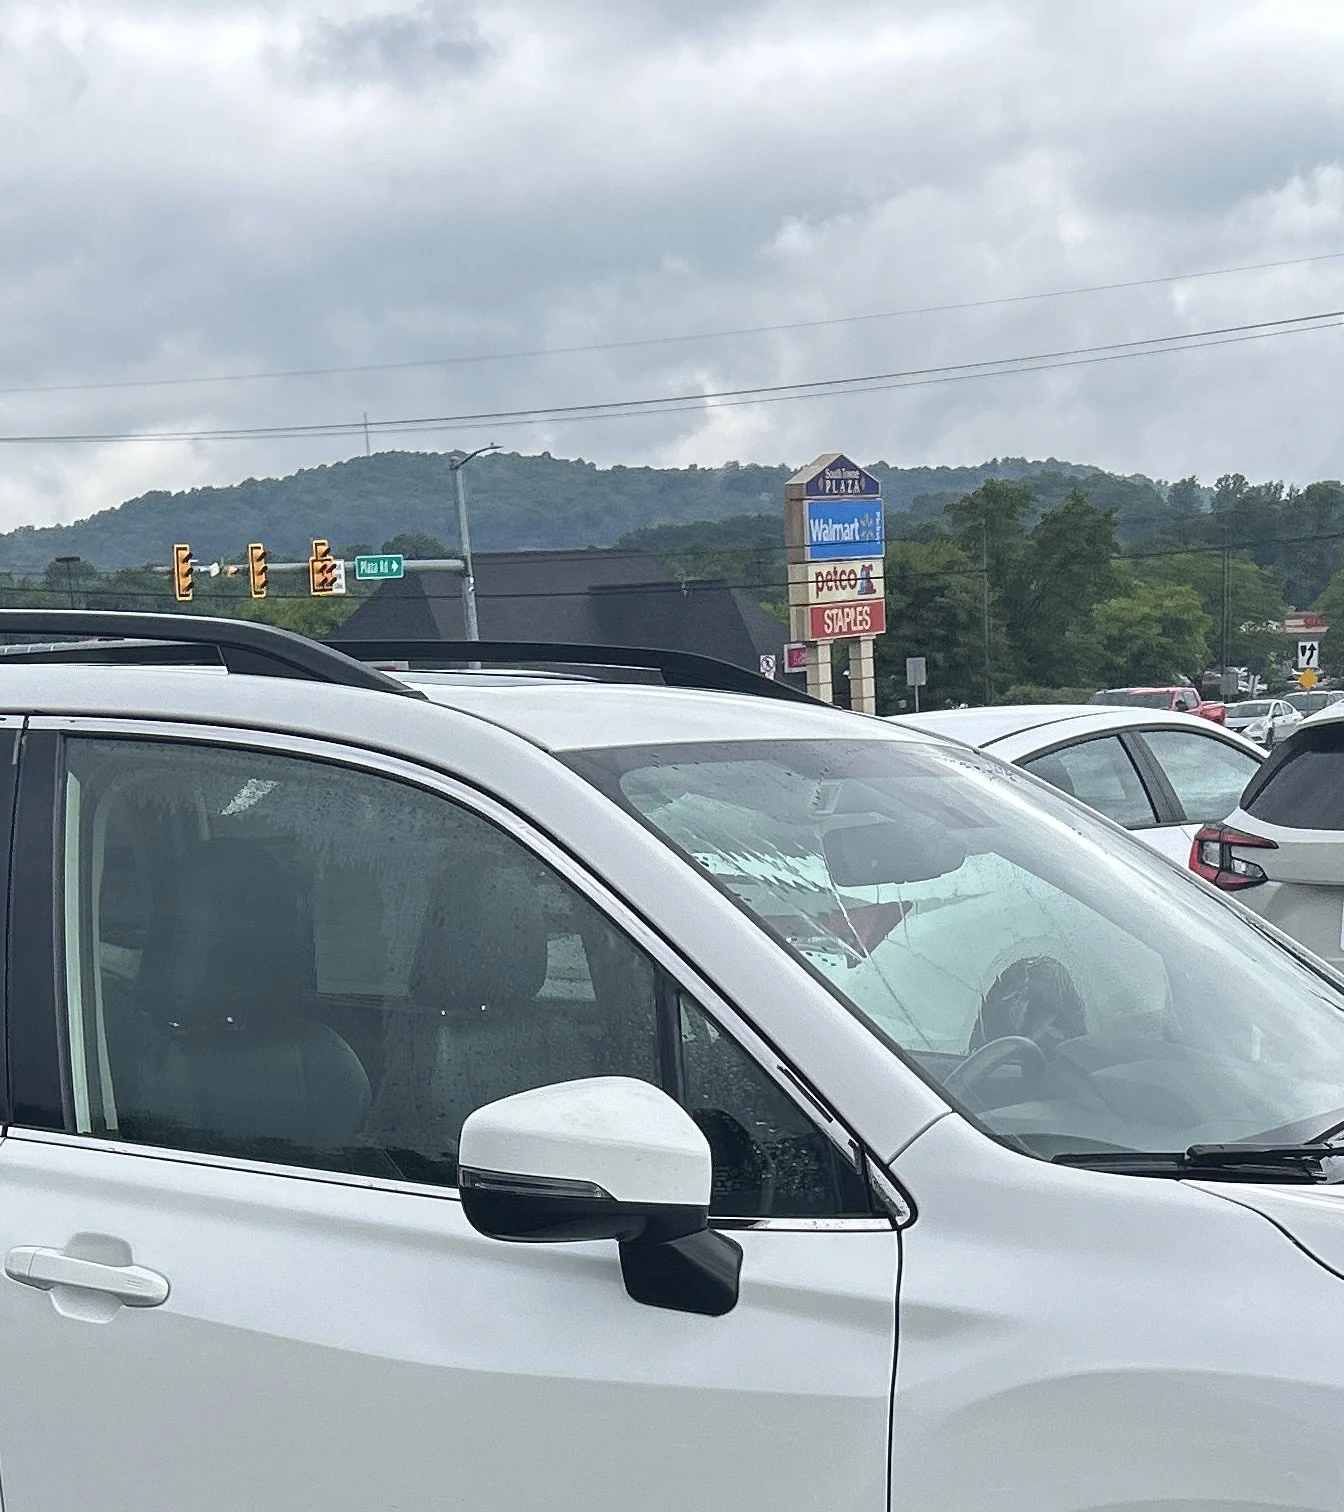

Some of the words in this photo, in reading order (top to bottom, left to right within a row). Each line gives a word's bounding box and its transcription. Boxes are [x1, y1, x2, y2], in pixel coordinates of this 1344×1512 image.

[825, 479, 860, 494] PLAZA
[809, 517, 860, 542] Walmart
[815, 566, 858, 600] petco
[823, 605, 872, 635] STAPLES
